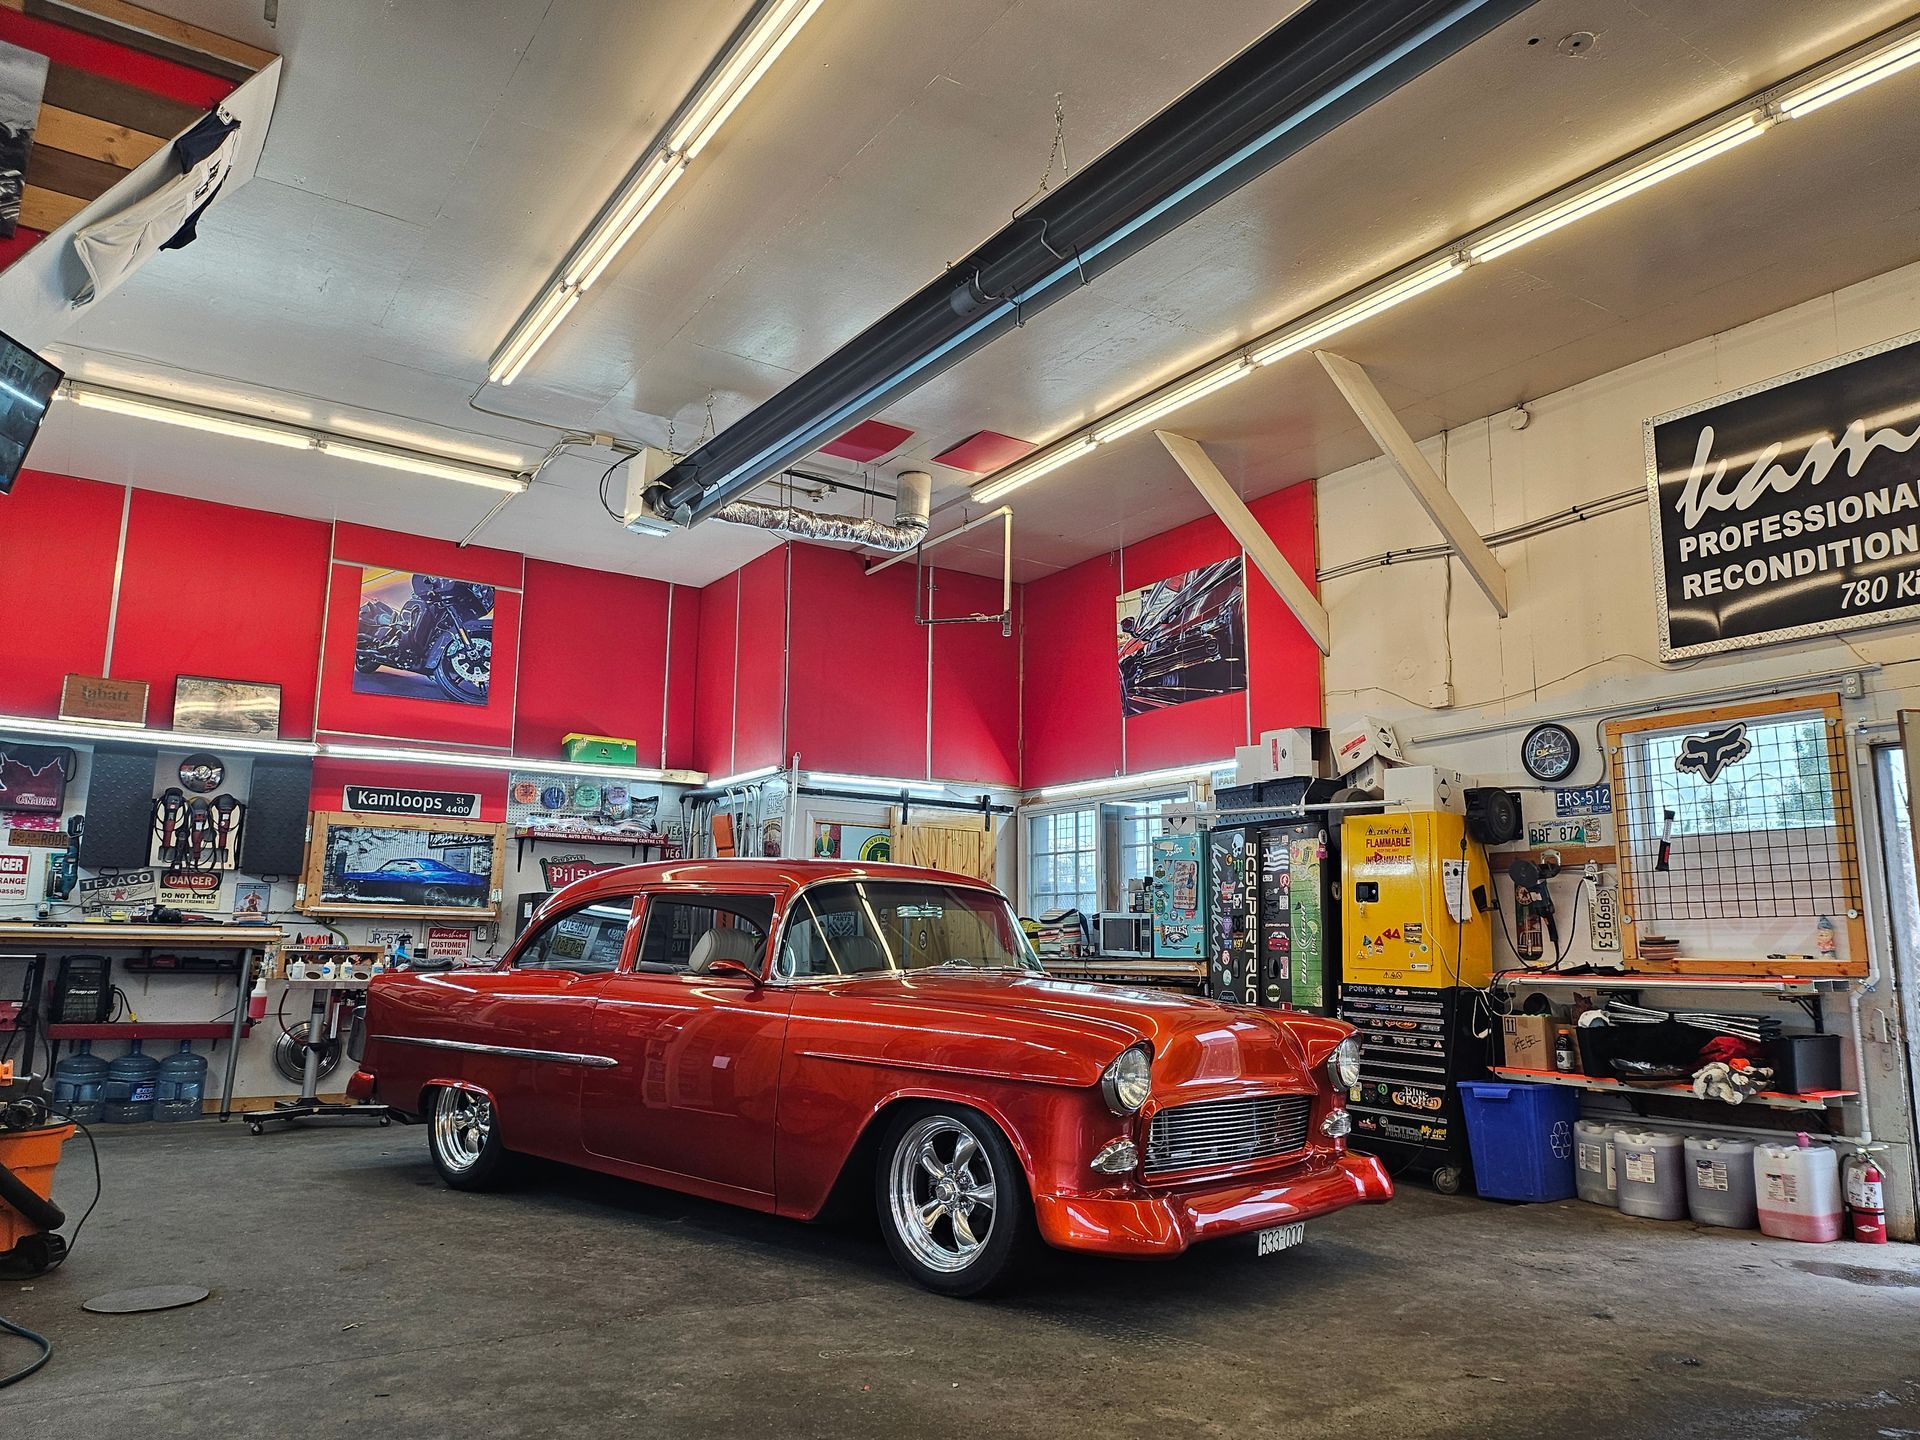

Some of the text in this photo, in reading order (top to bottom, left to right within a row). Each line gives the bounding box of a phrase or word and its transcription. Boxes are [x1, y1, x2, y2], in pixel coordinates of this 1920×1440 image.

[1679, 480, 1920, 562] PROFESSIONA
[1682, 524, 1919, 600] RECONDITION
[1841, 576, 1889, 609] 780
[358, 791, 465, 812] Kamloops St
[445, 806, 470, 814] 4400
[602, 836, 638, 844] RECONDITIONING
[1530, 826, 1581, 843] BBF 872
[1366, 837, 1410, 848] FLAMMABLE
[82, 873, 151, 889] TEXACO
[169, 875, 213, 886] DANGER
[1165, 924, 1189, 935] EAGLES
[1246, 842, 1257, 1006] BCSUPERTRUC
[431, 930, 468, 938] kamshine
[431, 941, 466, 949] CUSTOMER
[1405, 1086, 1428, 1097] Blue
[1398, 1092, 1434, 1108] Grotto
[1386, 1124, 1421, 1137] MOTION
